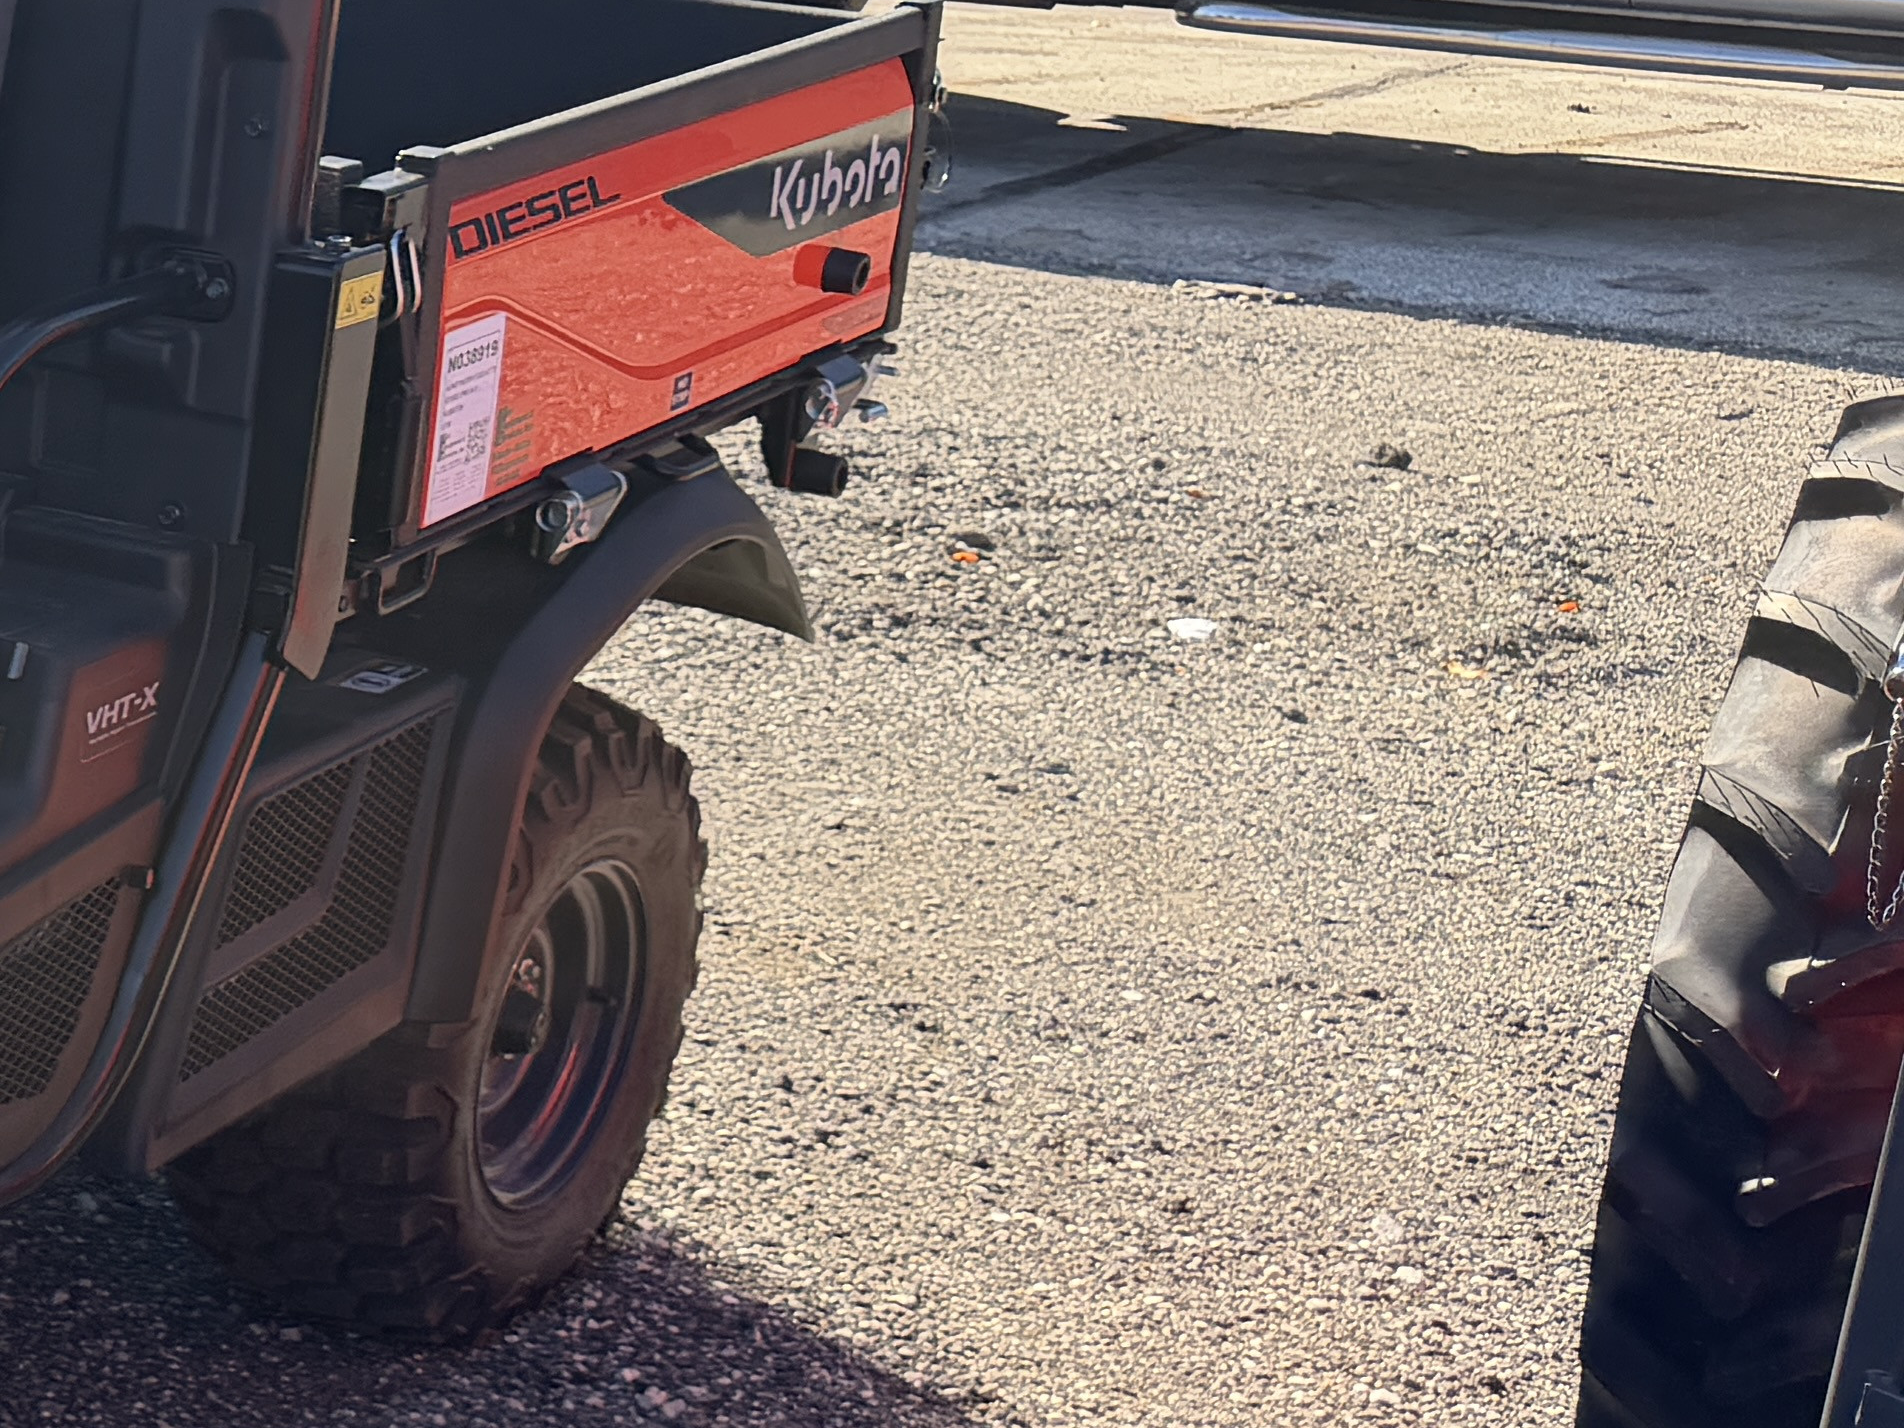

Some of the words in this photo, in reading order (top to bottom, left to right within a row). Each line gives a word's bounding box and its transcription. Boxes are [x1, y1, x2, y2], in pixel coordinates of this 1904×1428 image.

[448, 175, 621, 259] DIESEL
[769, 133, 901, 231] Kubota
[85, 681, 160, 735] VHT-X
